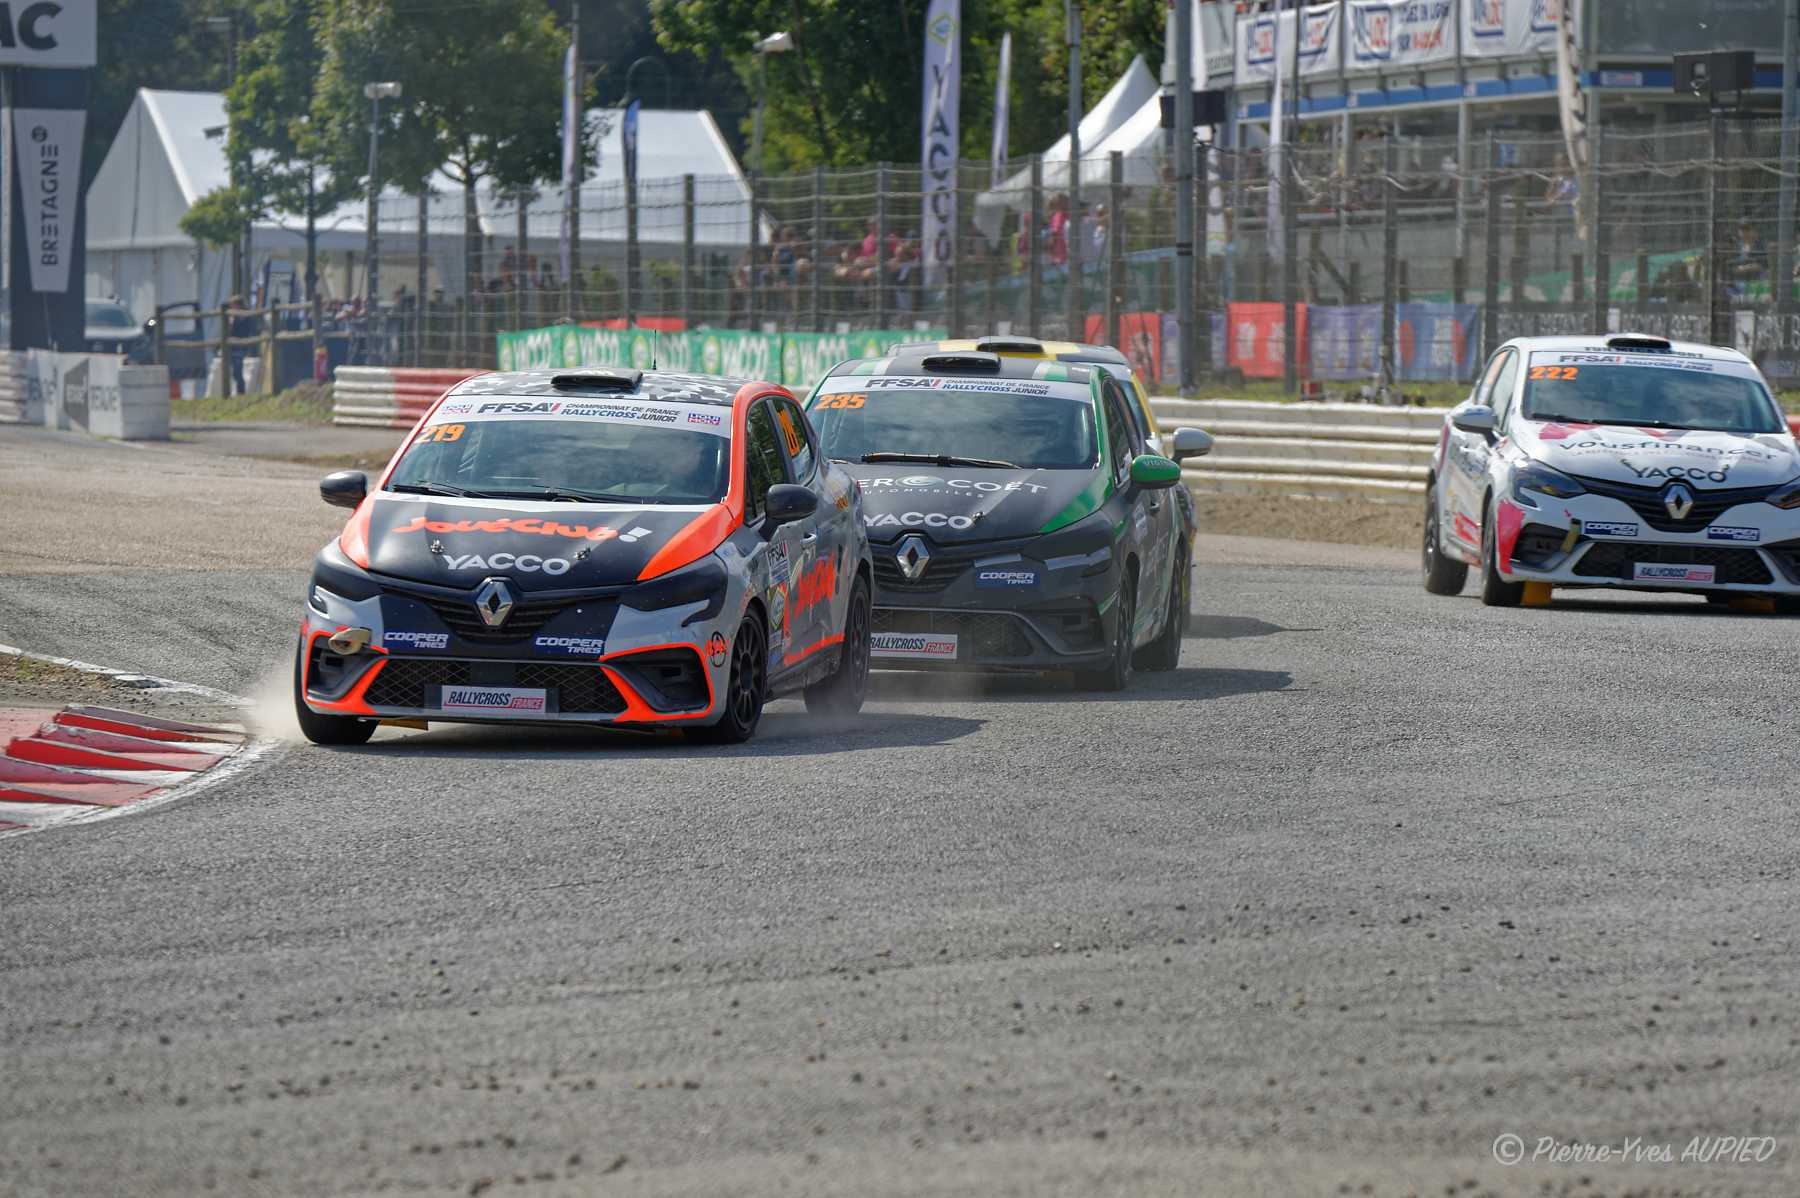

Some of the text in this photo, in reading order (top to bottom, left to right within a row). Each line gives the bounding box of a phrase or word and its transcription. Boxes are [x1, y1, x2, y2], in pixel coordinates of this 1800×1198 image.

[928, 64, 951, 262] YACCO
[40, 144, 59, 266] BRETAGNE
[1529, 366, 1579, 381] 222
[865, 378, 933, 388] FFSA
[942, 383, 1048, 396] RALLYCROSS JUNIOR
[477, 402, 555, 414] FFSA
[566, 403, 630, 412] CHAMPIONNAT
[645, 408, 681, 416] FRANCE
[814, 394, 868, 411] 235
[560, 408, 678, 423] RALLYCROSS JUNIOR
[414, 423, 466, 444] 219
[1560, 440, 1777, 460] vousfinancer
[1630, 466, 1727, 483] YACCO
[864, 487, 985, 499] UTOMOBILES
[864, 511, 974, 530] YACCO
[1586, 522, 1638, 532] COOPER
[1709, 527, 1759, 536] COOPER
[442, 552, 571, 576] YACCO
[979, 571, 1035, 580] COOPER
[1639, 567, 1688, 578] RALLYCROSS
[383, 632, 449, 644] COOPER
[413, 640, 447, 649] TIRES
[535, 636, 605, 649] COOPER
[870, 636, 955, 653] RALLYCROSS FRANCE
[567, 645, 602, 655] TIRES
[448, 690, 544, 710] RALLYCROSS FRANCE
